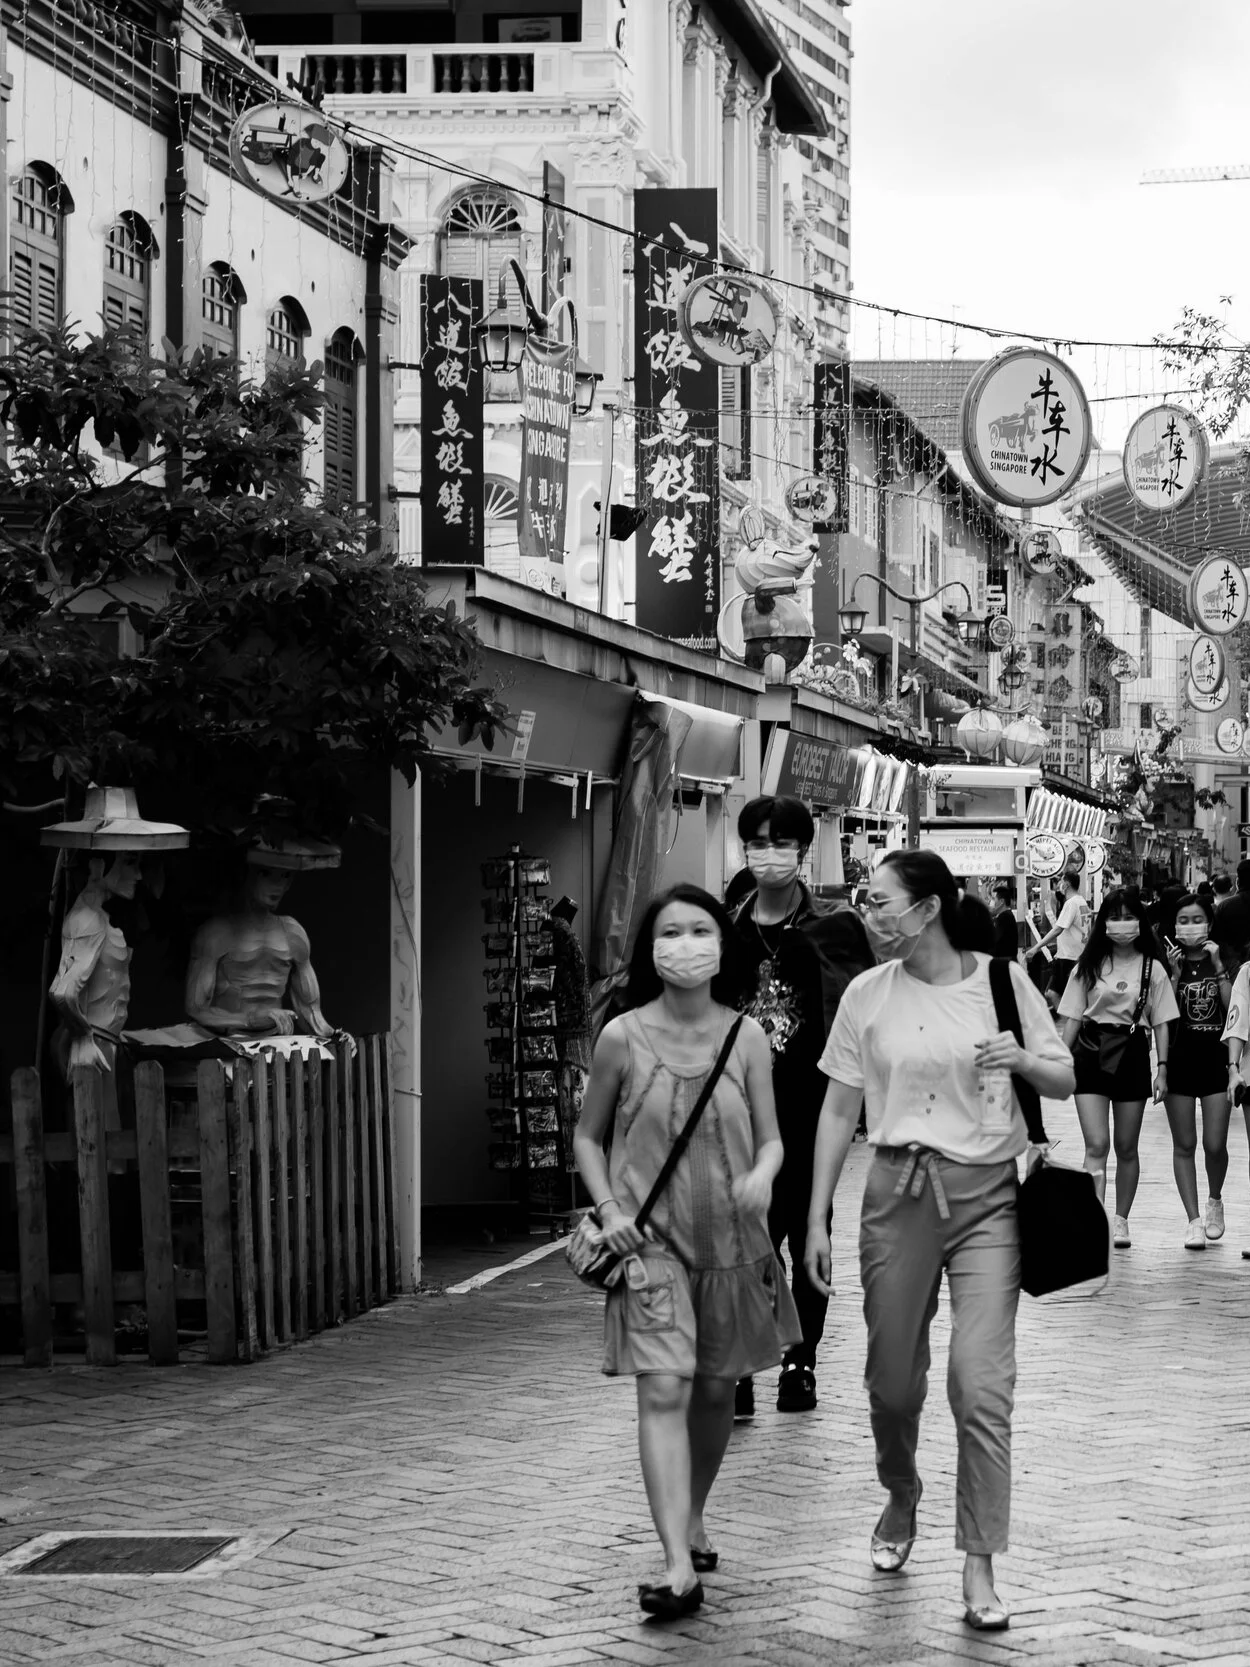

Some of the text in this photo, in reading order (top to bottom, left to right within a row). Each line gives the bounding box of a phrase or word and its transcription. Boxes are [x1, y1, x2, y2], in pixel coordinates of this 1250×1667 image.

[563, 371, 573, 398] TO
[527, 428, 566, 462] SNGAORE
[990, 450, 1028, 463] CHINATOWN
[990, 462, 1027, 475] SINGAPORE
[1136, 476, 1160, 484] CHINATOWN
[1136, 483, 1159, 491] SINGAPORE
[791, 741, 829, 780] EUROBEST
[1046, 751, 1075, 762] HIANG
